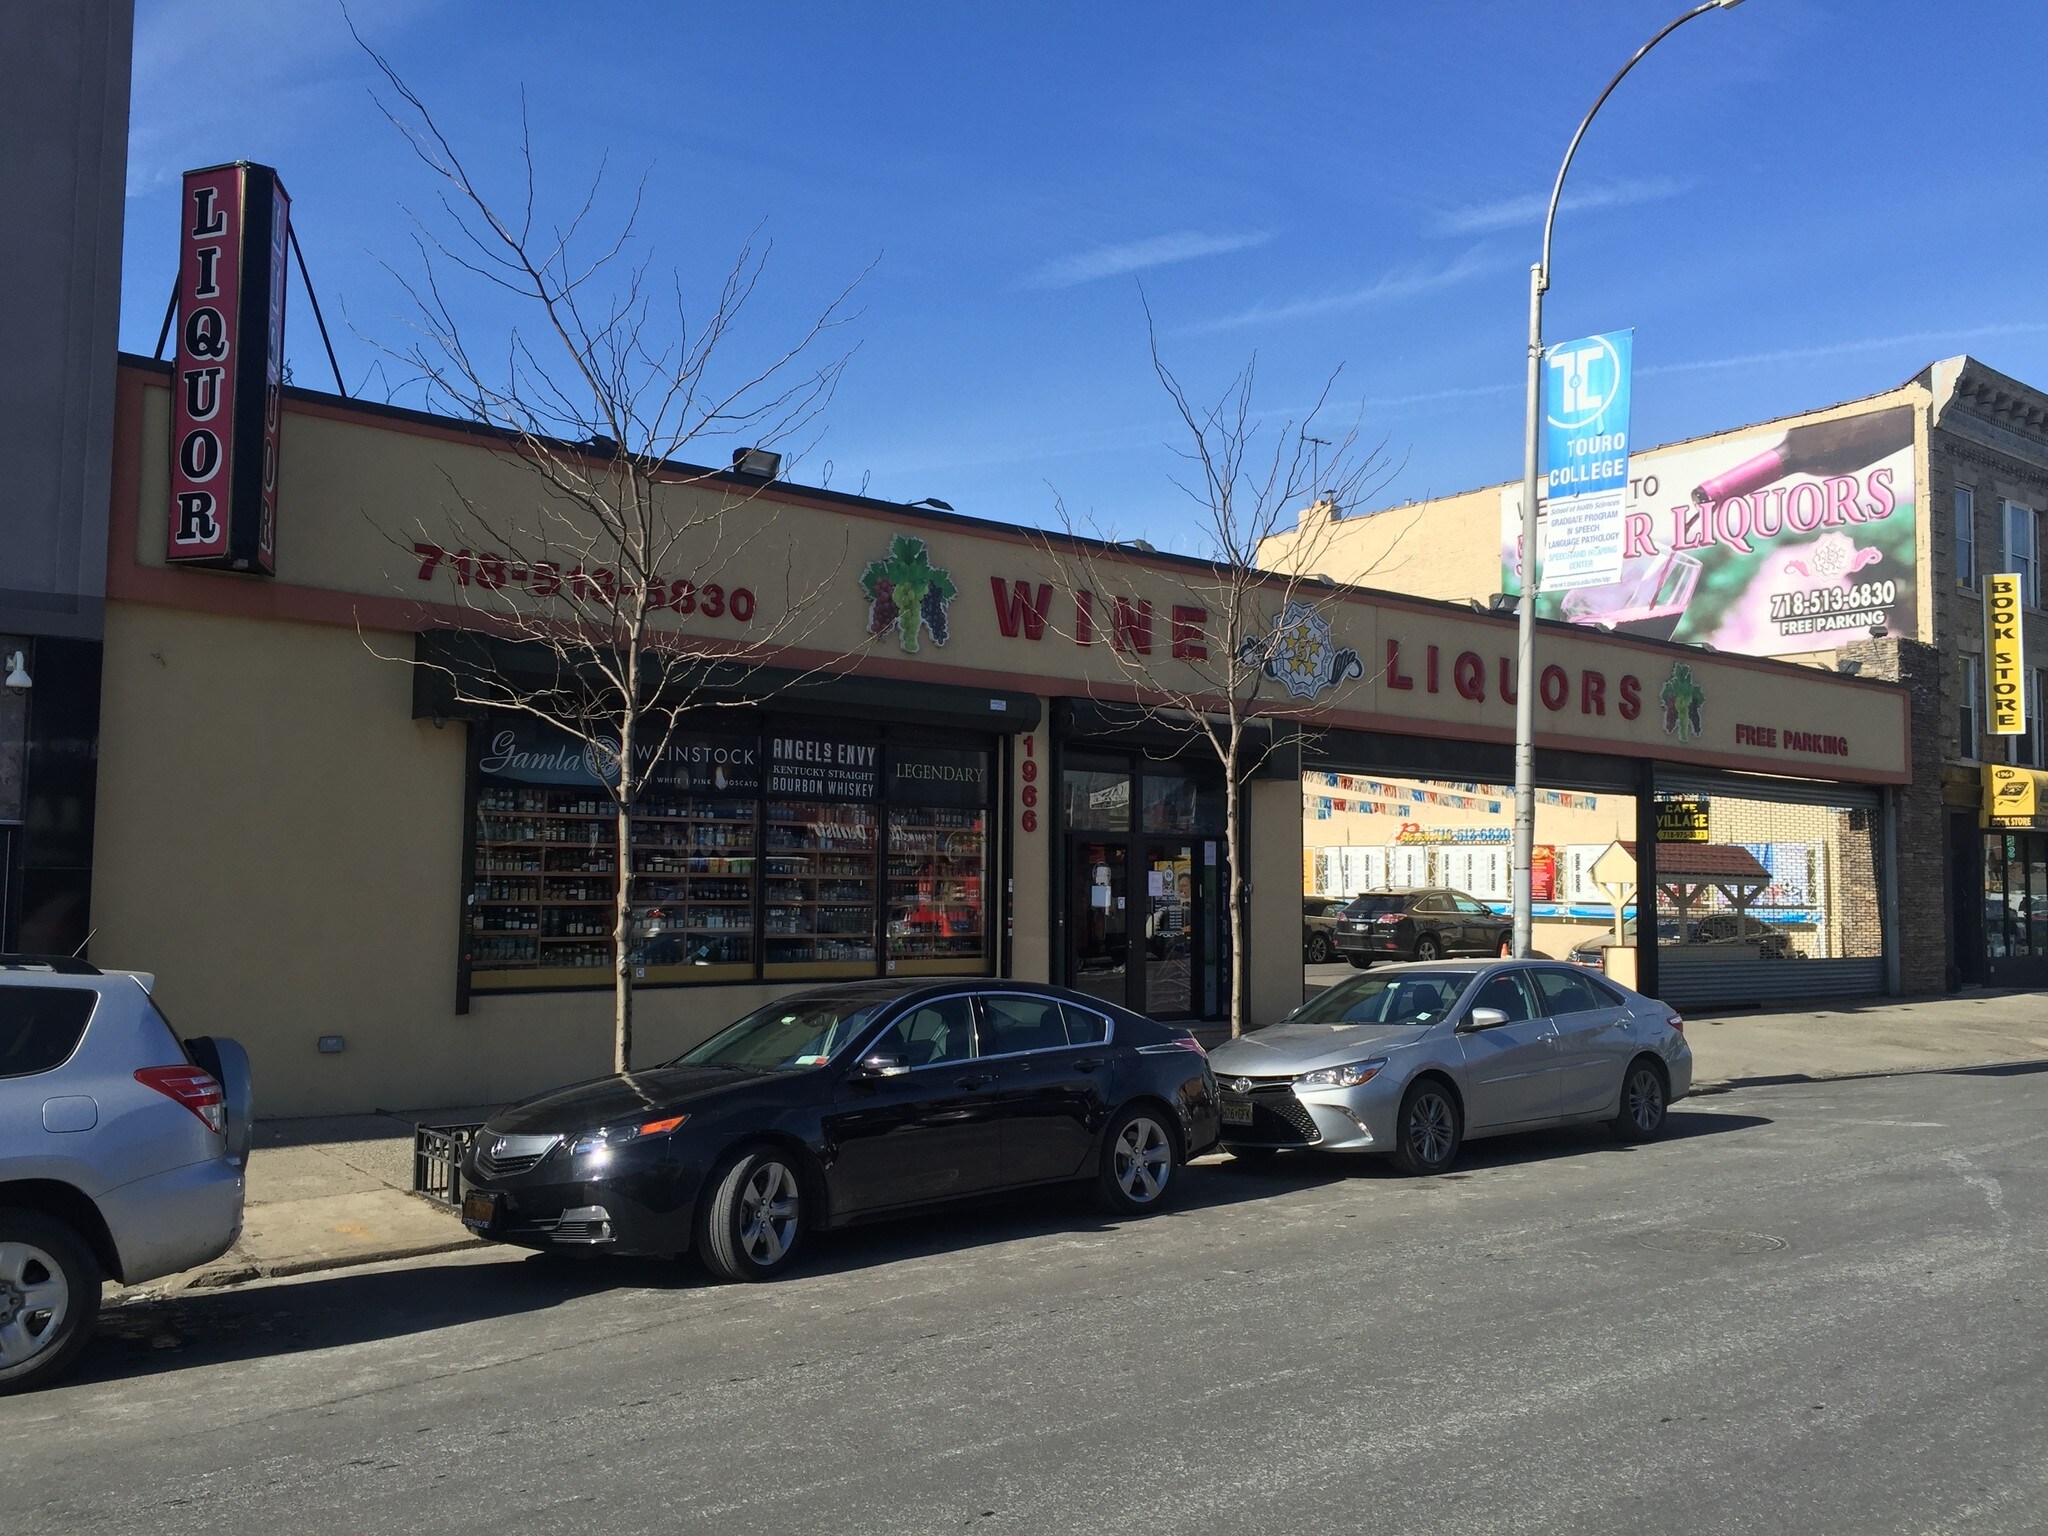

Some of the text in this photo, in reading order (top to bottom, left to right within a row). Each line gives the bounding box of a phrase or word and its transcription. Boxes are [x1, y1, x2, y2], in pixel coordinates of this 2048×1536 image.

[175, 186, 229, 544] LIQUOR
[1567, 432, 1626, 458] TOURO
[1549, 462, 1625, 487] COLLEGE
[1629, 475, 1660, 499] TO
[1551, 507, 1568, 515] School
[1595, 500, 1620, 509] Sciences
[1551, 510, 1618, 527] GRADUATE PROGRAM
[1671, 468, 1895, 555] LIQUORS
[1548, 532, 1620, 549] LANGUAGE PATHOLOGY
[1567, 524, 1600, 535] IN SPEECH
[1548, 546, 1618, 562] SPEECH AND HEARING
[1569, 559, 1593, 570] CENTER
[1770, 581, 1896, 617] 718-513-6830
[990, 576, 1208, 660] WINE
[1781, 610, 1885, 636] FREE PARKING
[1991, 581, 2018, 726] BOOK STORE
[1386, 638, 1643, 721] LIQUORS
[1735, 723, 1849, 757] FREE PARKING
[479, 730, 581, 774] Gamla
[635, 744, 754, 766] WEINSTOCK
[837, 743, 876, 767] ENVY
[657, 777, 681, 785] WHITE
[773, 765, 875, 781] KENTUCKY STRAIGHT
[896, 763, 984, 783] LEGENDARY
[1021, 735, 1038, 832] 1966
[773, 777, 874, 797] BOURBON WHISKEY
[1665, 803, 1698, 813] CAFE
[1655, 814, 1708, 827] VILLAGE
[2011, 817, 2032, 826] STORE
